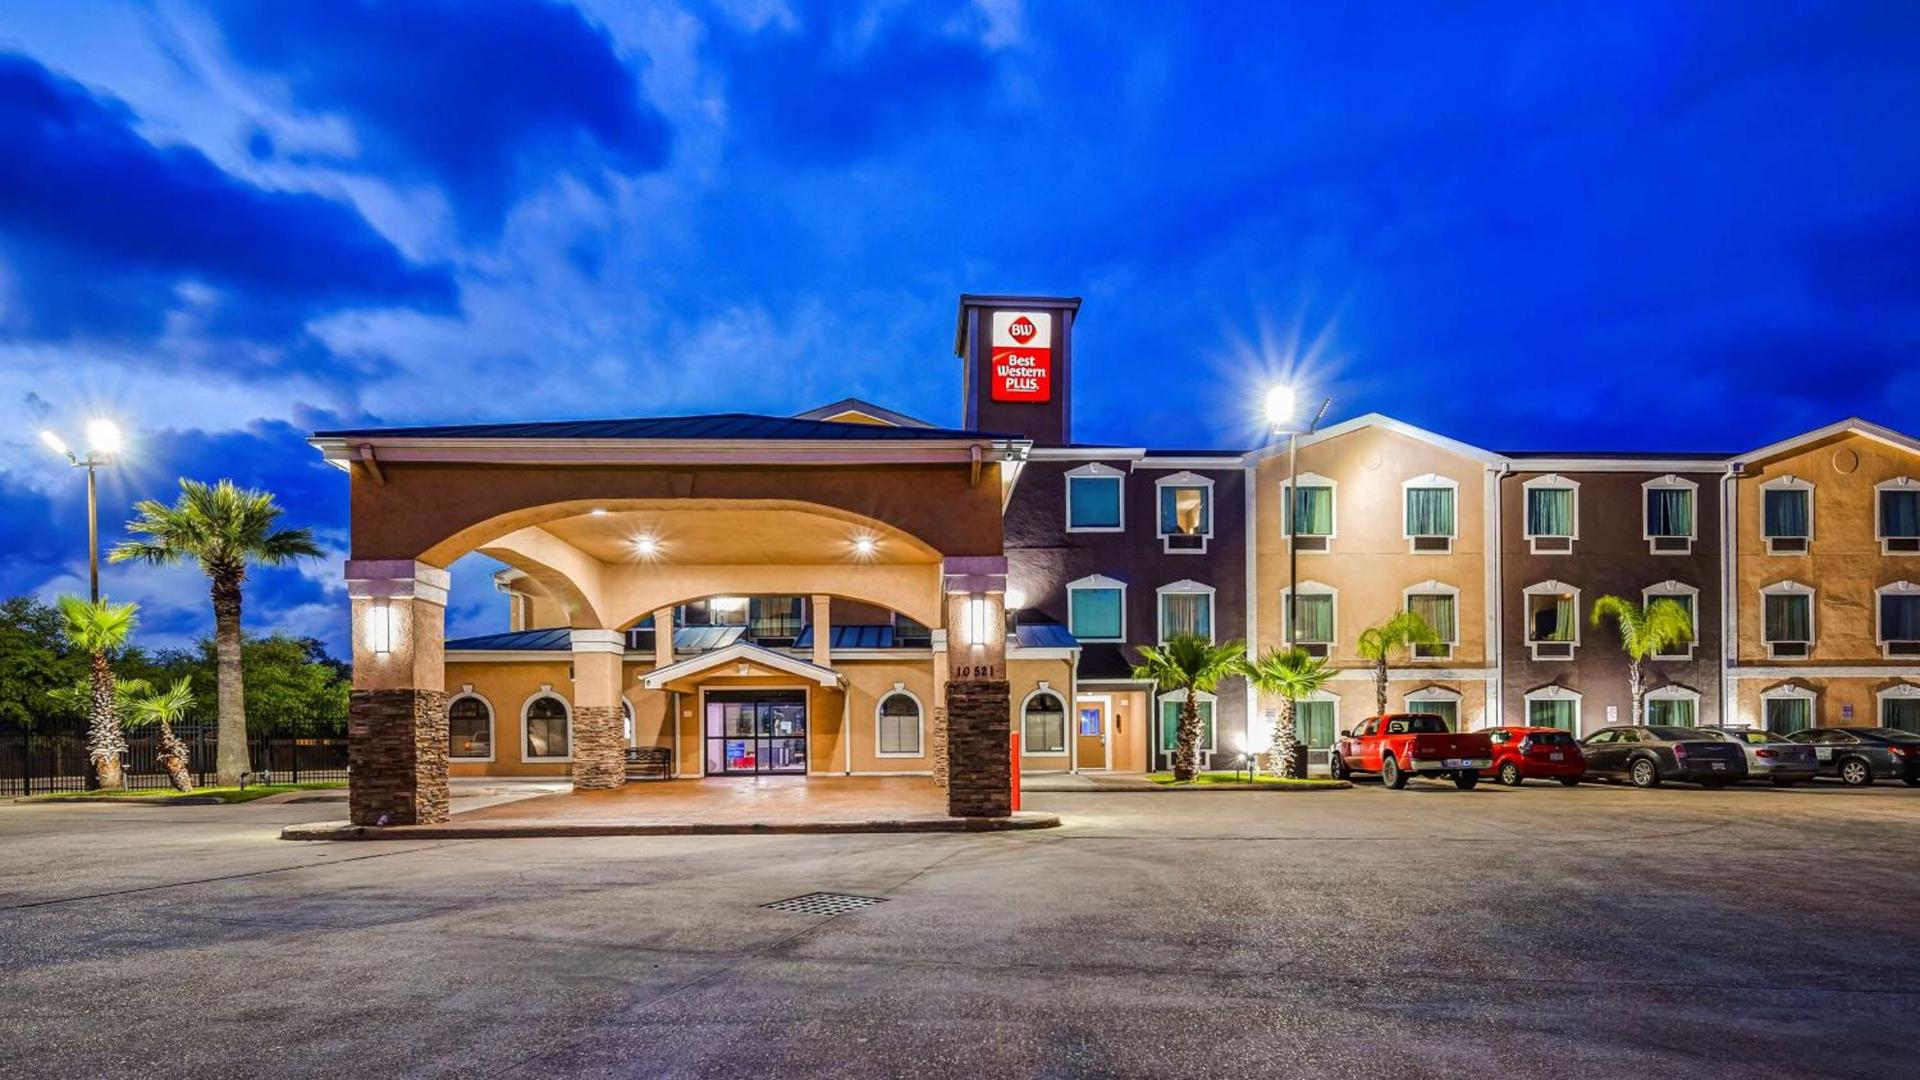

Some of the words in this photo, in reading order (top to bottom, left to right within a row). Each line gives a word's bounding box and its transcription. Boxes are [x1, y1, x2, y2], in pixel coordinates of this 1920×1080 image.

[1011, 324, 1033, 336] BW
[1008, 354, 1036, 367] Best
[996, 365, 1047, 378] Western
